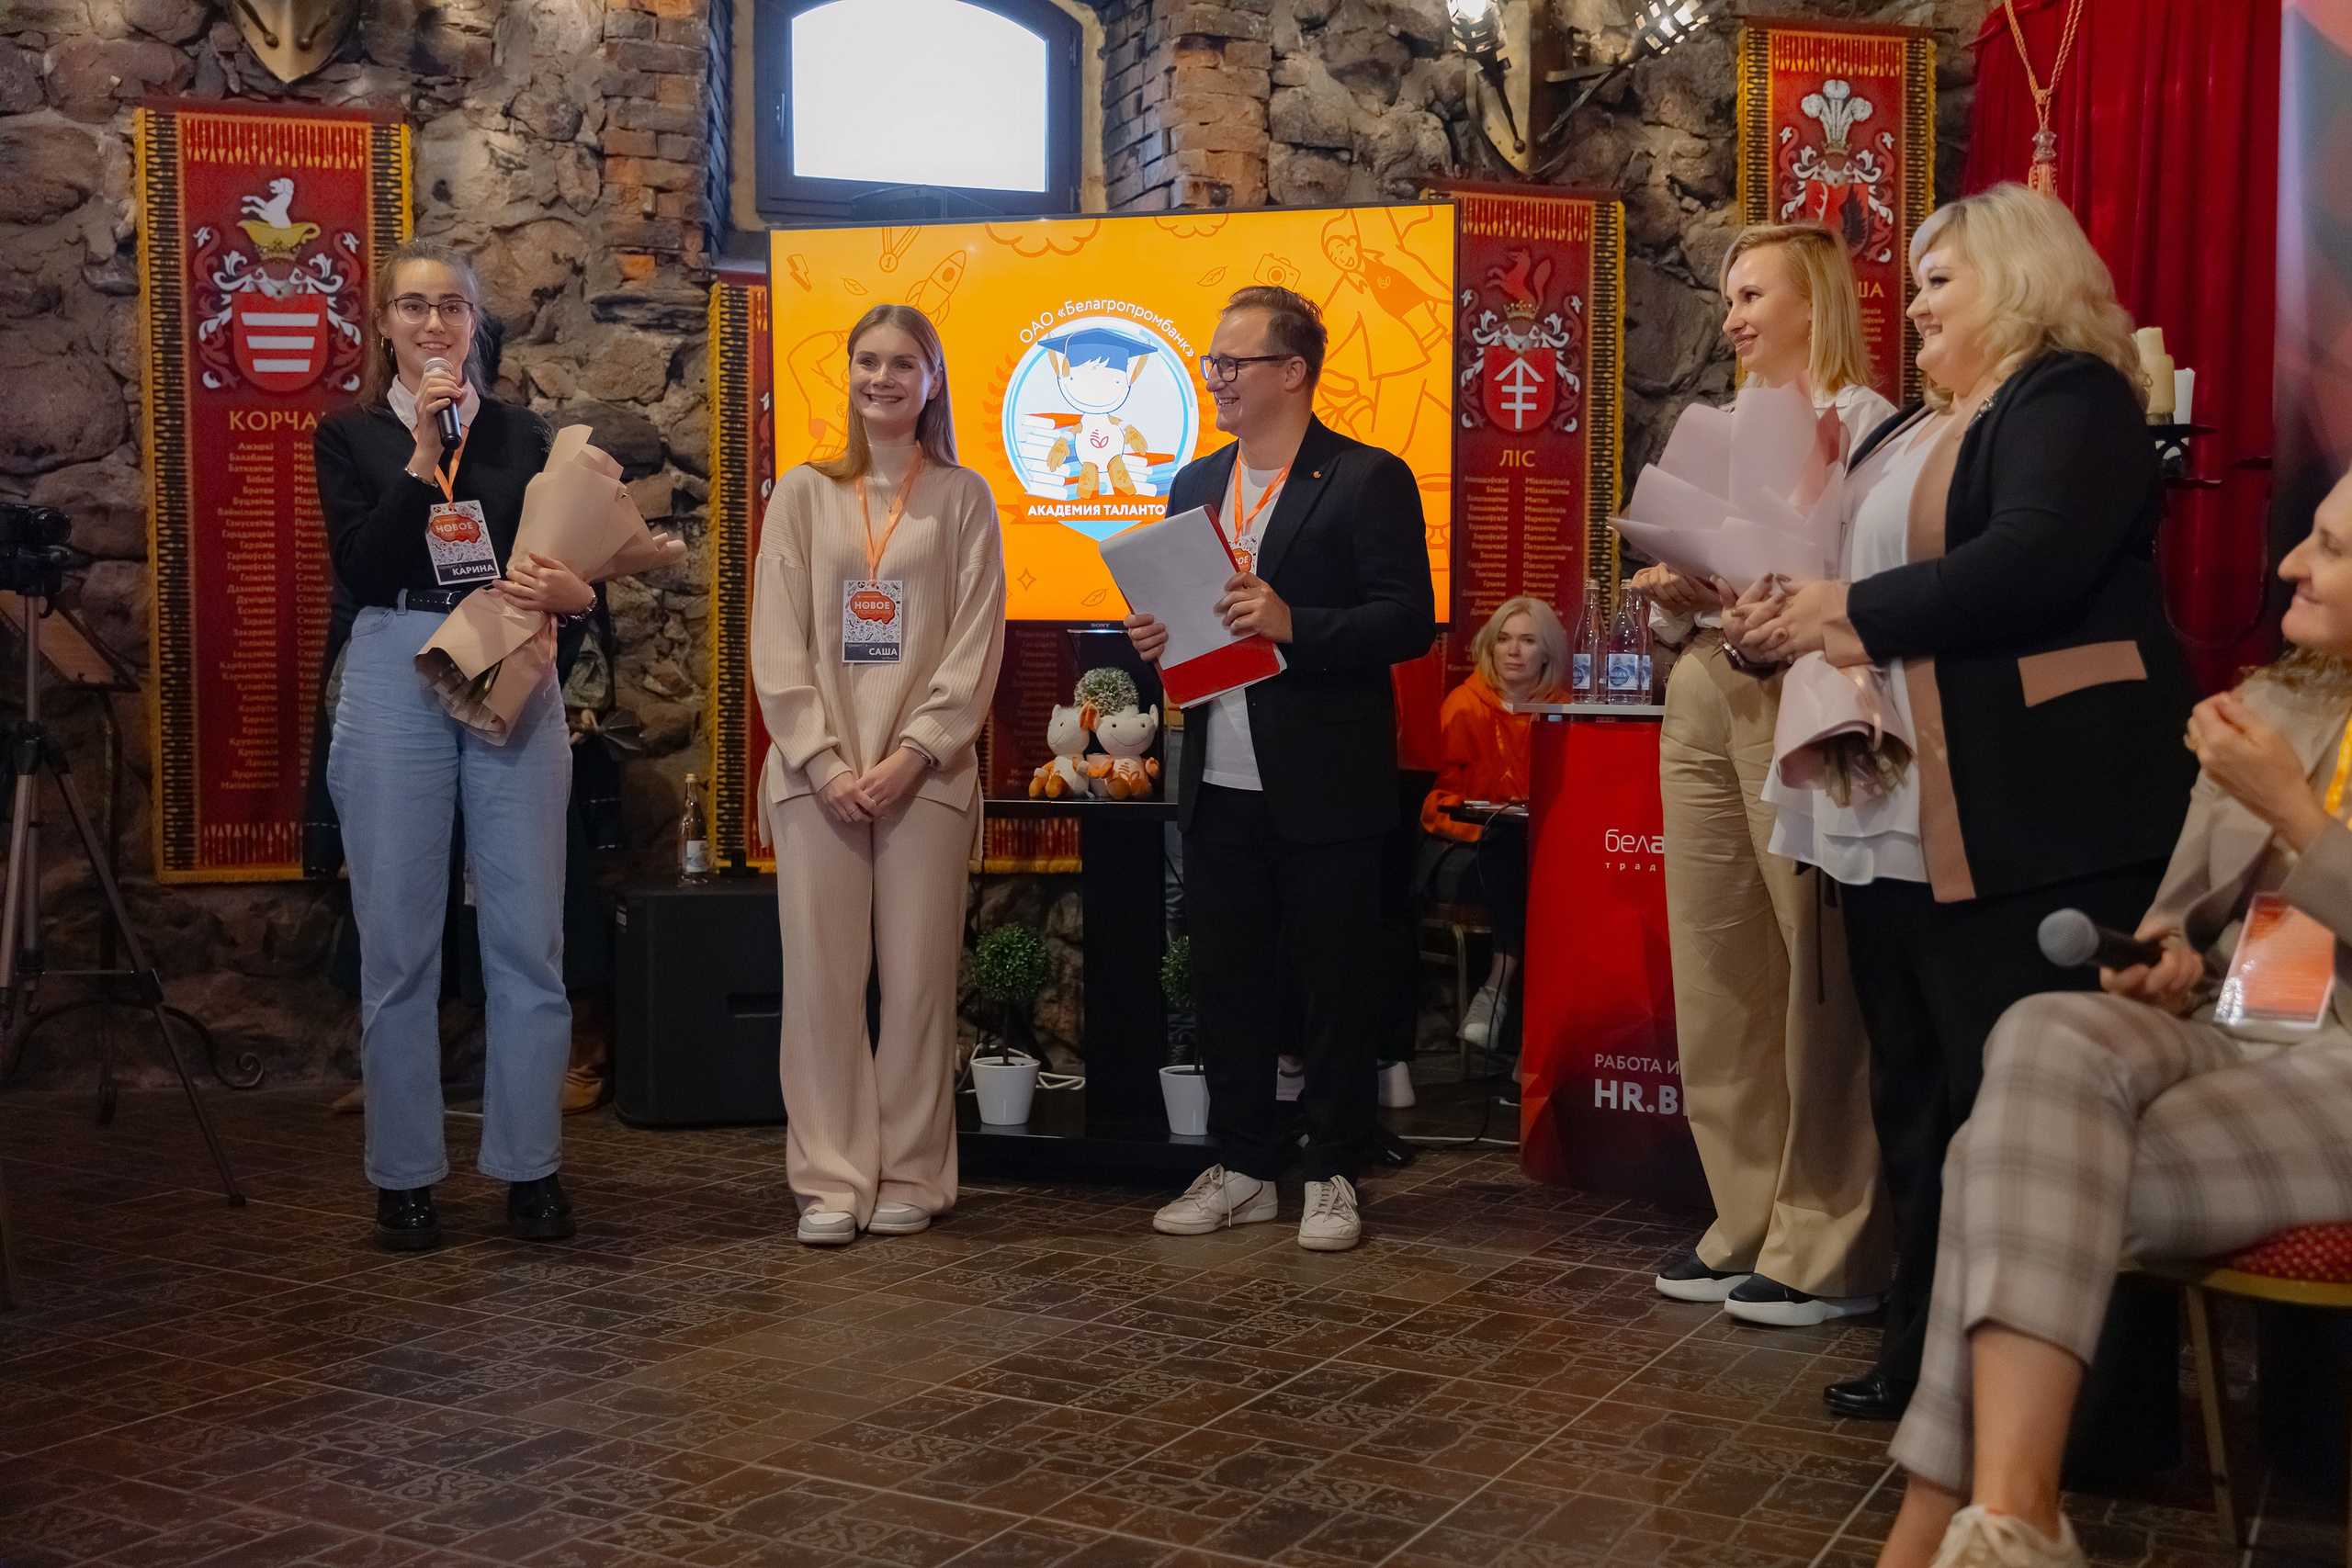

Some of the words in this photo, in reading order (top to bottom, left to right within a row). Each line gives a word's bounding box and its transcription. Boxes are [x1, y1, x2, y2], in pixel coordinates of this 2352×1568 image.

[1019, 311, 1054, 344] ОАО
[1057, 299, 1194, 357] «Белагропромбанк»
[229, 410, 325, 431] КОРЧА
[1498, 449, 1535, 468] ЛІС
[1027, 504, 1101, 517] АКАДЕМИЯ
[1102, 504, 1168, 517] ТАЛАНТО
[435, 522, 474, 533] НОВОЕ
[452, 564, 494, 576] КАРИНА
[854, 601, 890, 610] НОВОЕ
[868, 648, 898, 656] САША
[1594, 1054, 1662, 1074] РАБОТА
[1594, 1078, 1689, 1117] HR.B
